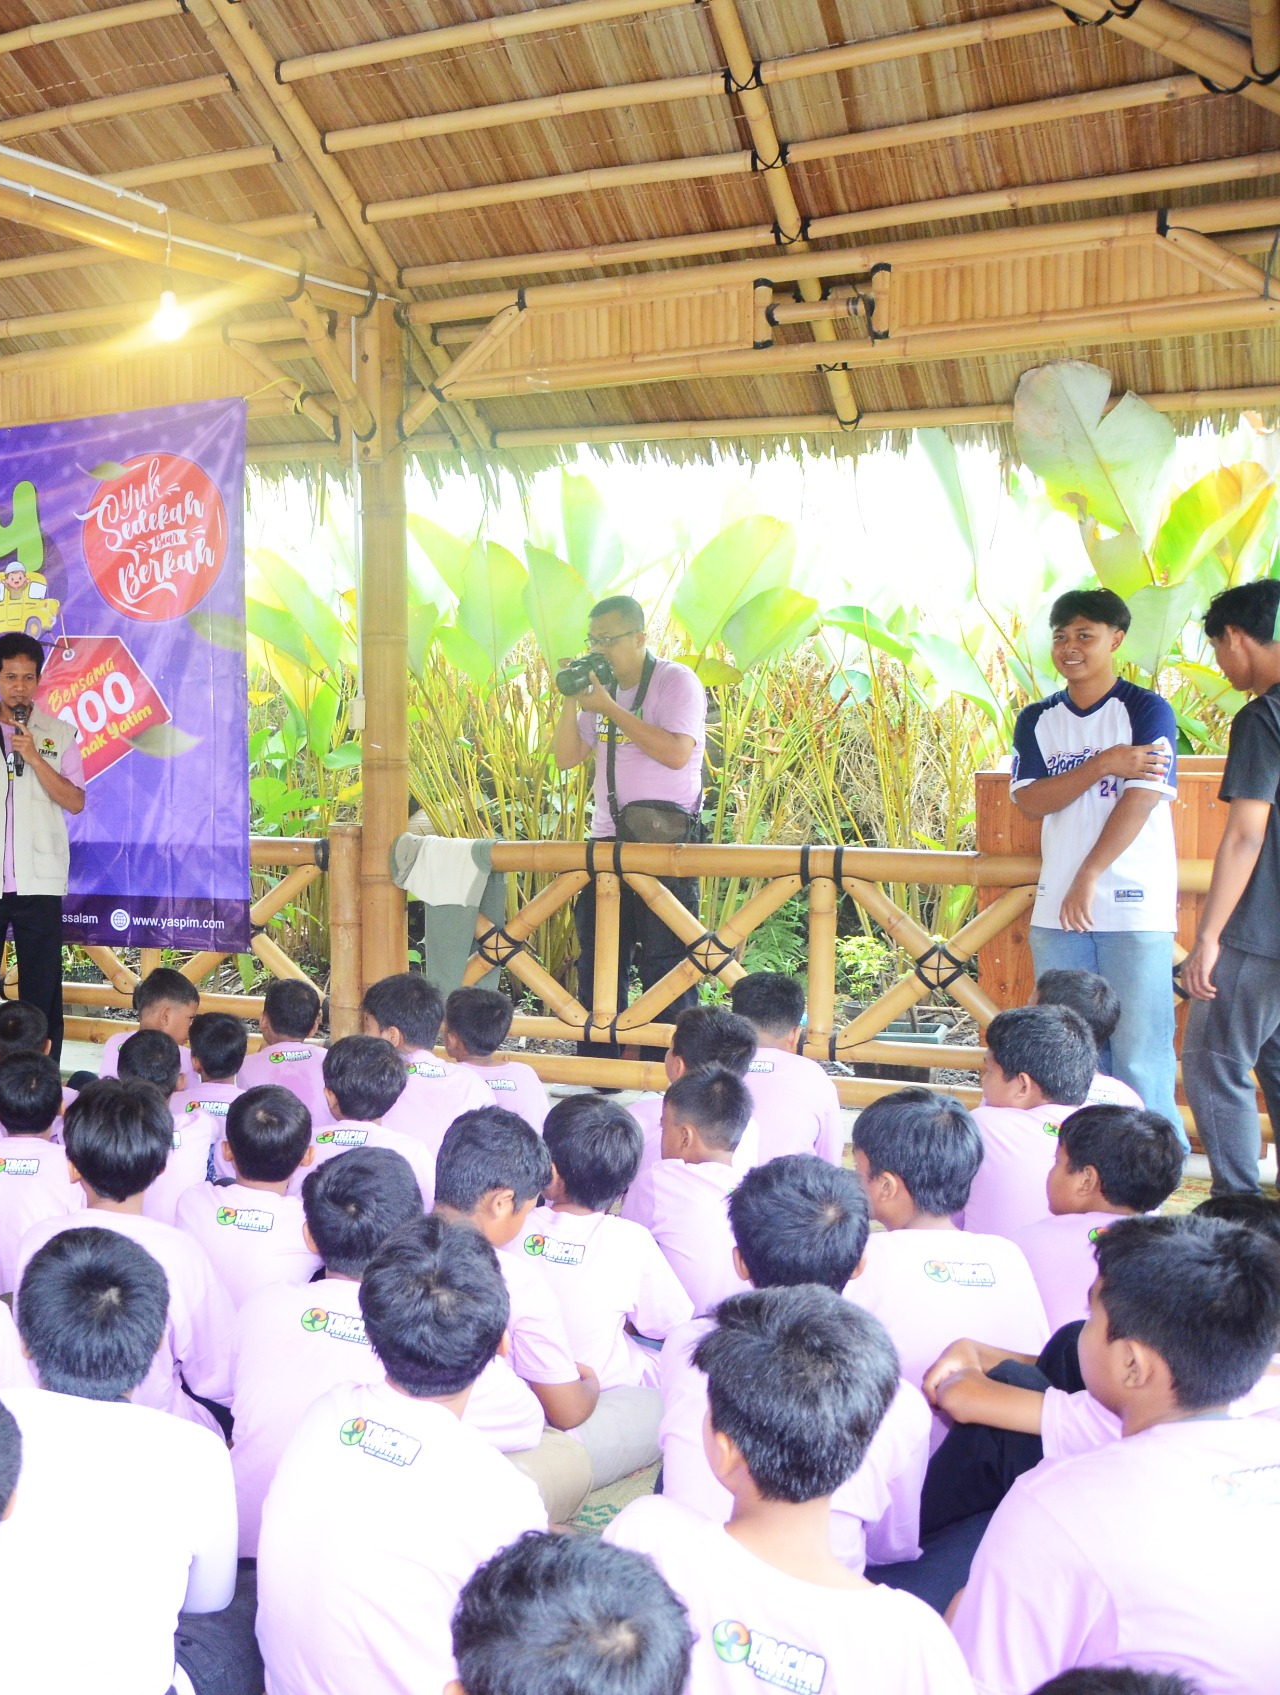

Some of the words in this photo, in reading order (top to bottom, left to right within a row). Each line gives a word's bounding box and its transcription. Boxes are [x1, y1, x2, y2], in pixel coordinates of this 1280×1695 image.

[85, 491, 204, 560] Sedekah
[119, 538, 215, 604] Berkah
[48, 657, 115, 713] Bersama
[81, 733, 108, 759] nak
[105, 705, 153, 739] Yatim
[62, 913, 98, 924] ssalam
[132, 916, 225, 931] www.yaspim.com
